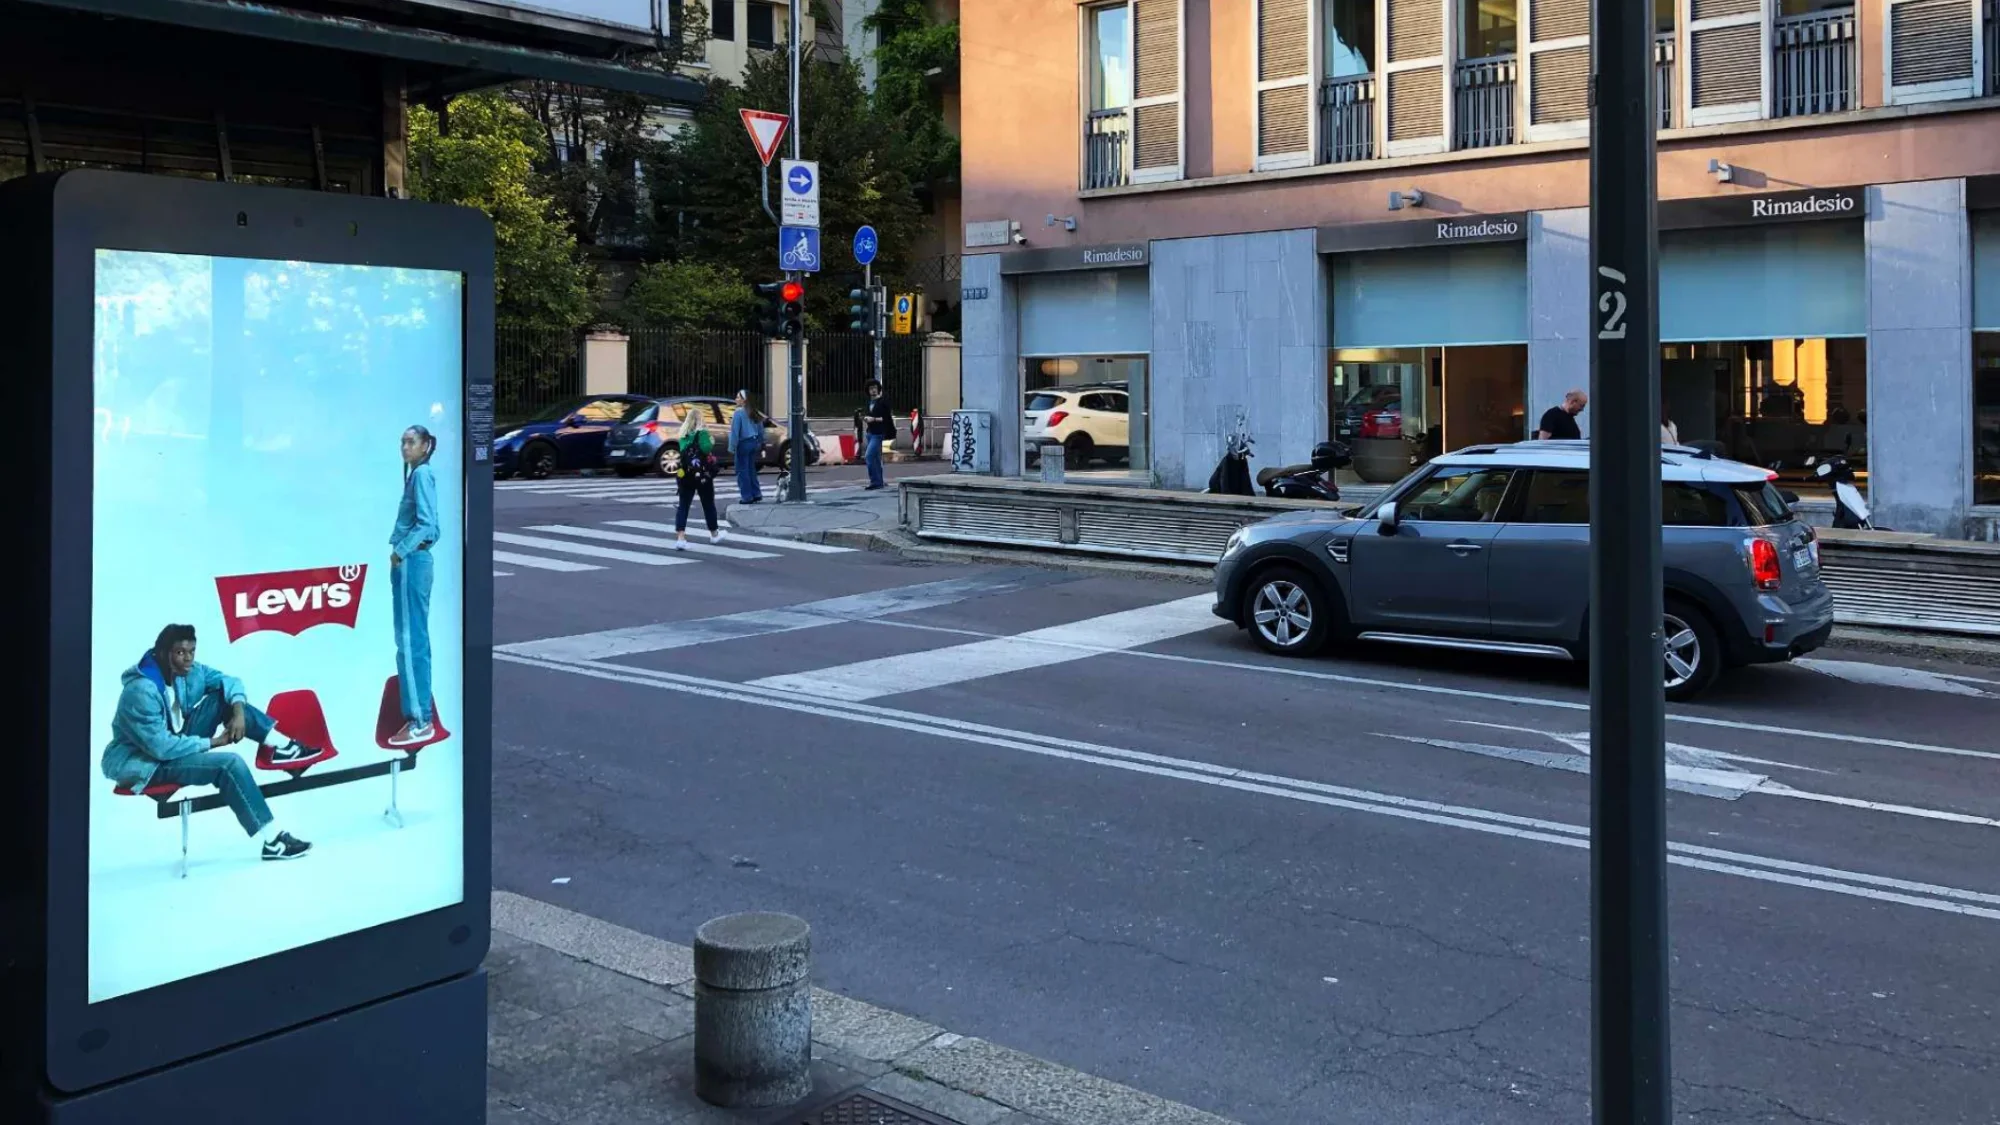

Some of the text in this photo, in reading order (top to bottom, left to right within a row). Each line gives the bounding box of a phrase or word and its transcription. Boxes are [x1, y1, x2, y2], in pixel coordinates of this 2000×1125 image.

[1753, 193, 1854, 217] Rimadesio
[1437, 219, 1518, 239] Rimadesio
[1083, 246, 1143, 263] Rimadesio
